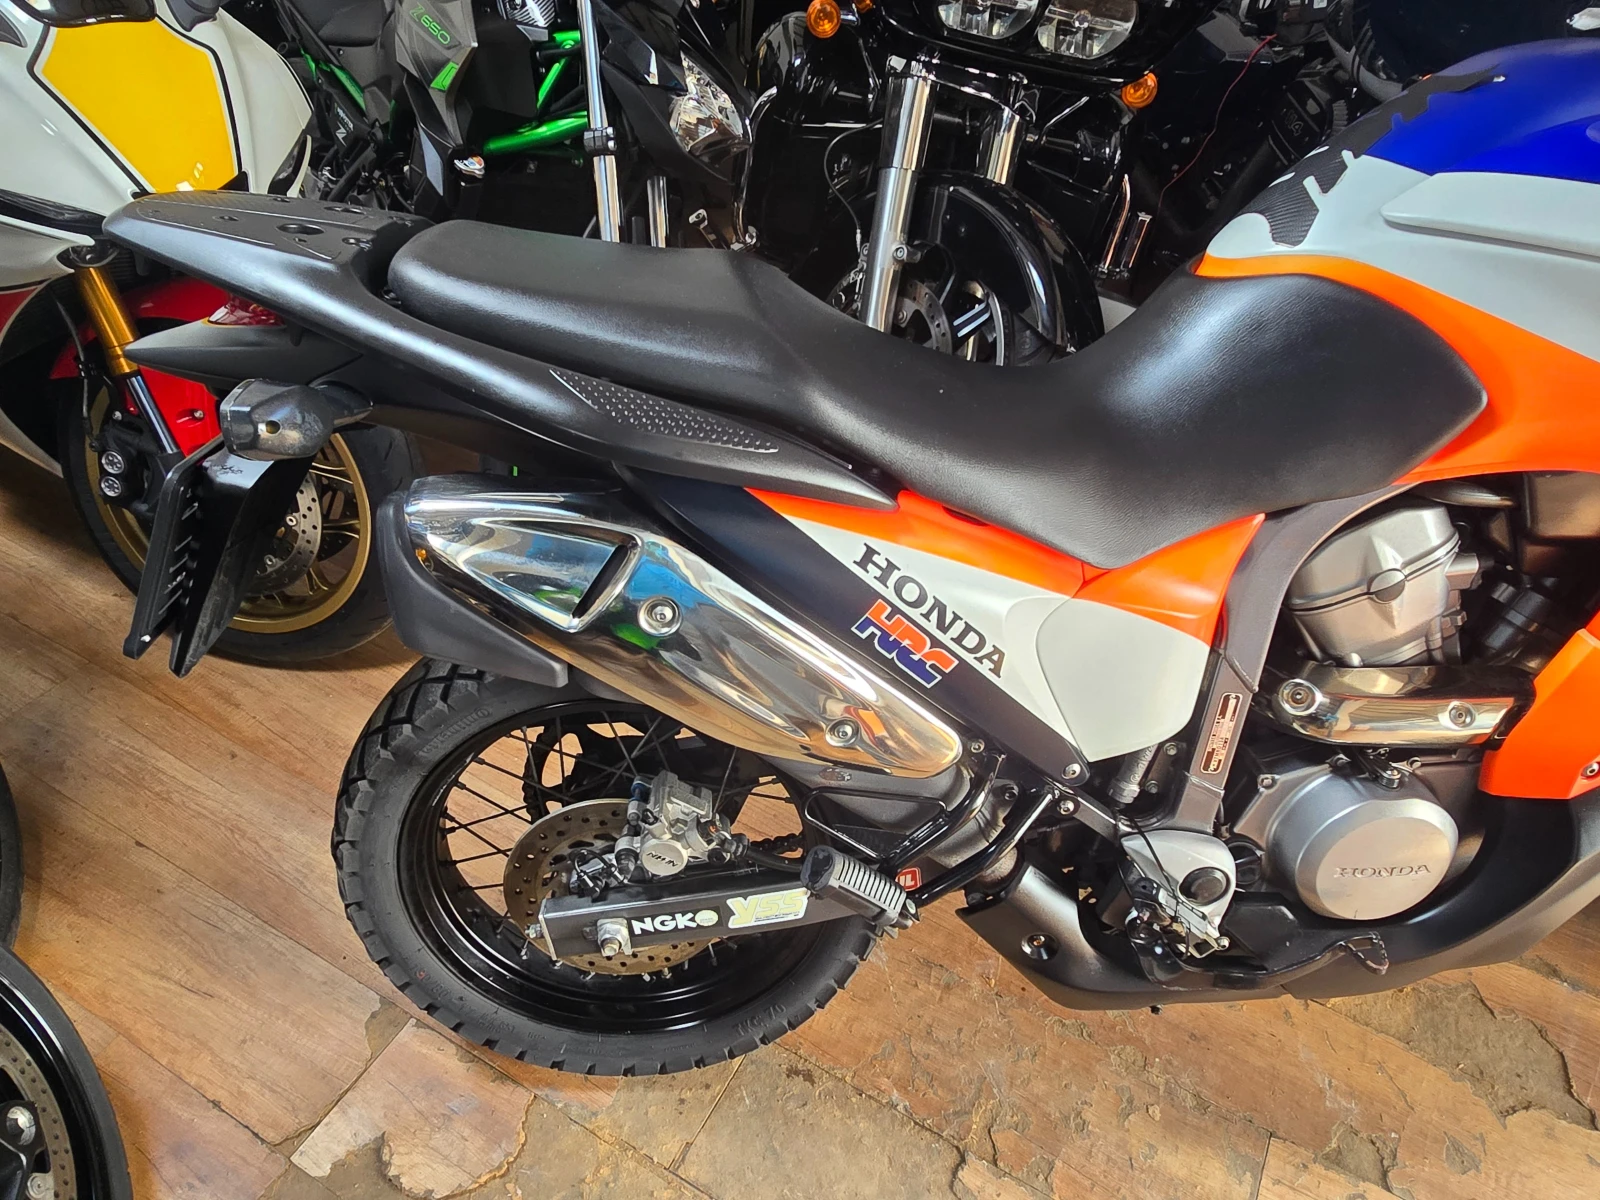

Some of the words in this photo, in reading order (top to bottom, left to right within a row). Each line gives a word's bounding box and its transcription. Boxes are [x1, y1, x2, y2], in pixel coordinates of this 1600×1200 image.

[409, 2, 451, 45] Z650
[852, 542, 1007, 679] HONDA
[850, 598, 960, 689] HRC
[1332, 863, 1431, 878] HONDA
[630, 911, 697, 935] NGK
[731, 891, 808, 926] YSS
[763, 1004, 787, 1021] 70
